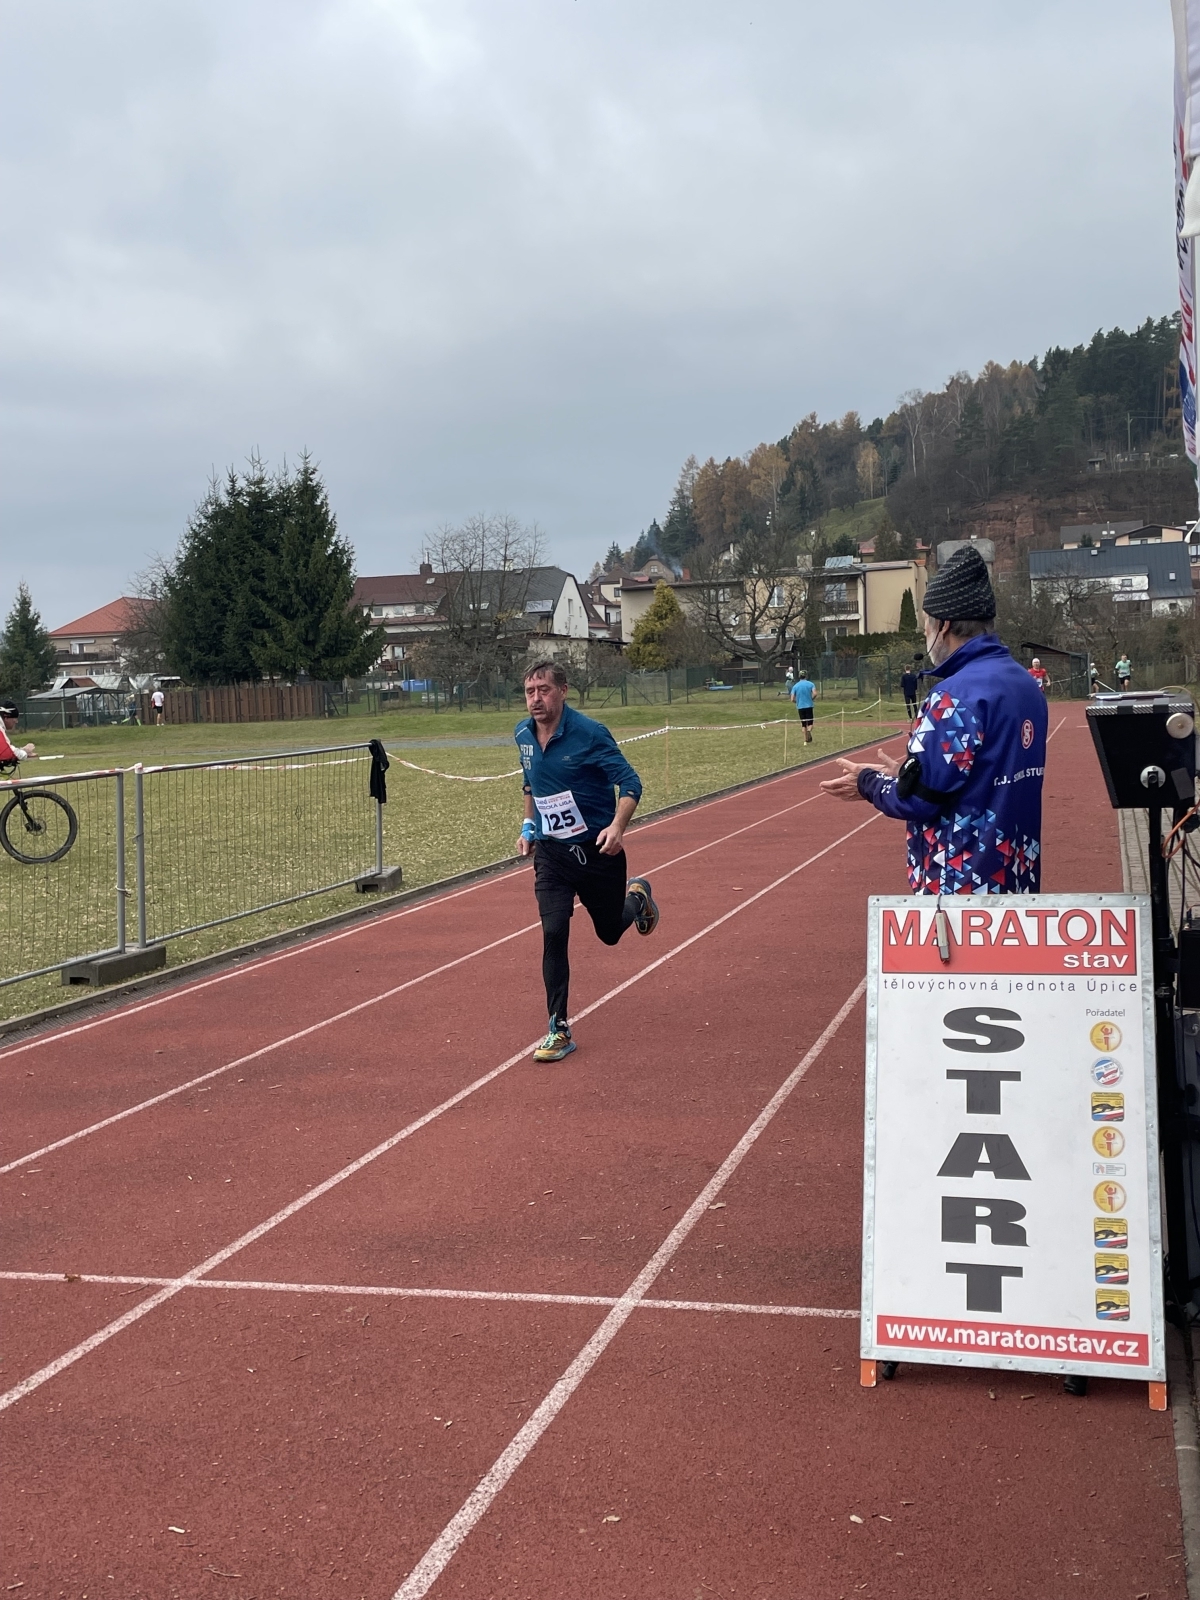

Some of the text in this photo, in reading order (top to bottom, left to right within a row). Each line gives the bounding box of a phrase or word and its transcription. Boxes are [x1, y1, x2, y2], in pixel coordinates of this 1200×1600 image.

[544, 810, 576, 831] 125
[882, 909, 1136, 946] MARATON
[1063, 951, 1129, 968] stav
[883, 978, 1138, 994] tělovýchovná jednota Úpice
[1085, 1008, 1126, 1017] Pořadatel
[936, 1006, 1033, 1314] START
[886, 1324, 1139, 1357] www.maratonstav.cz
